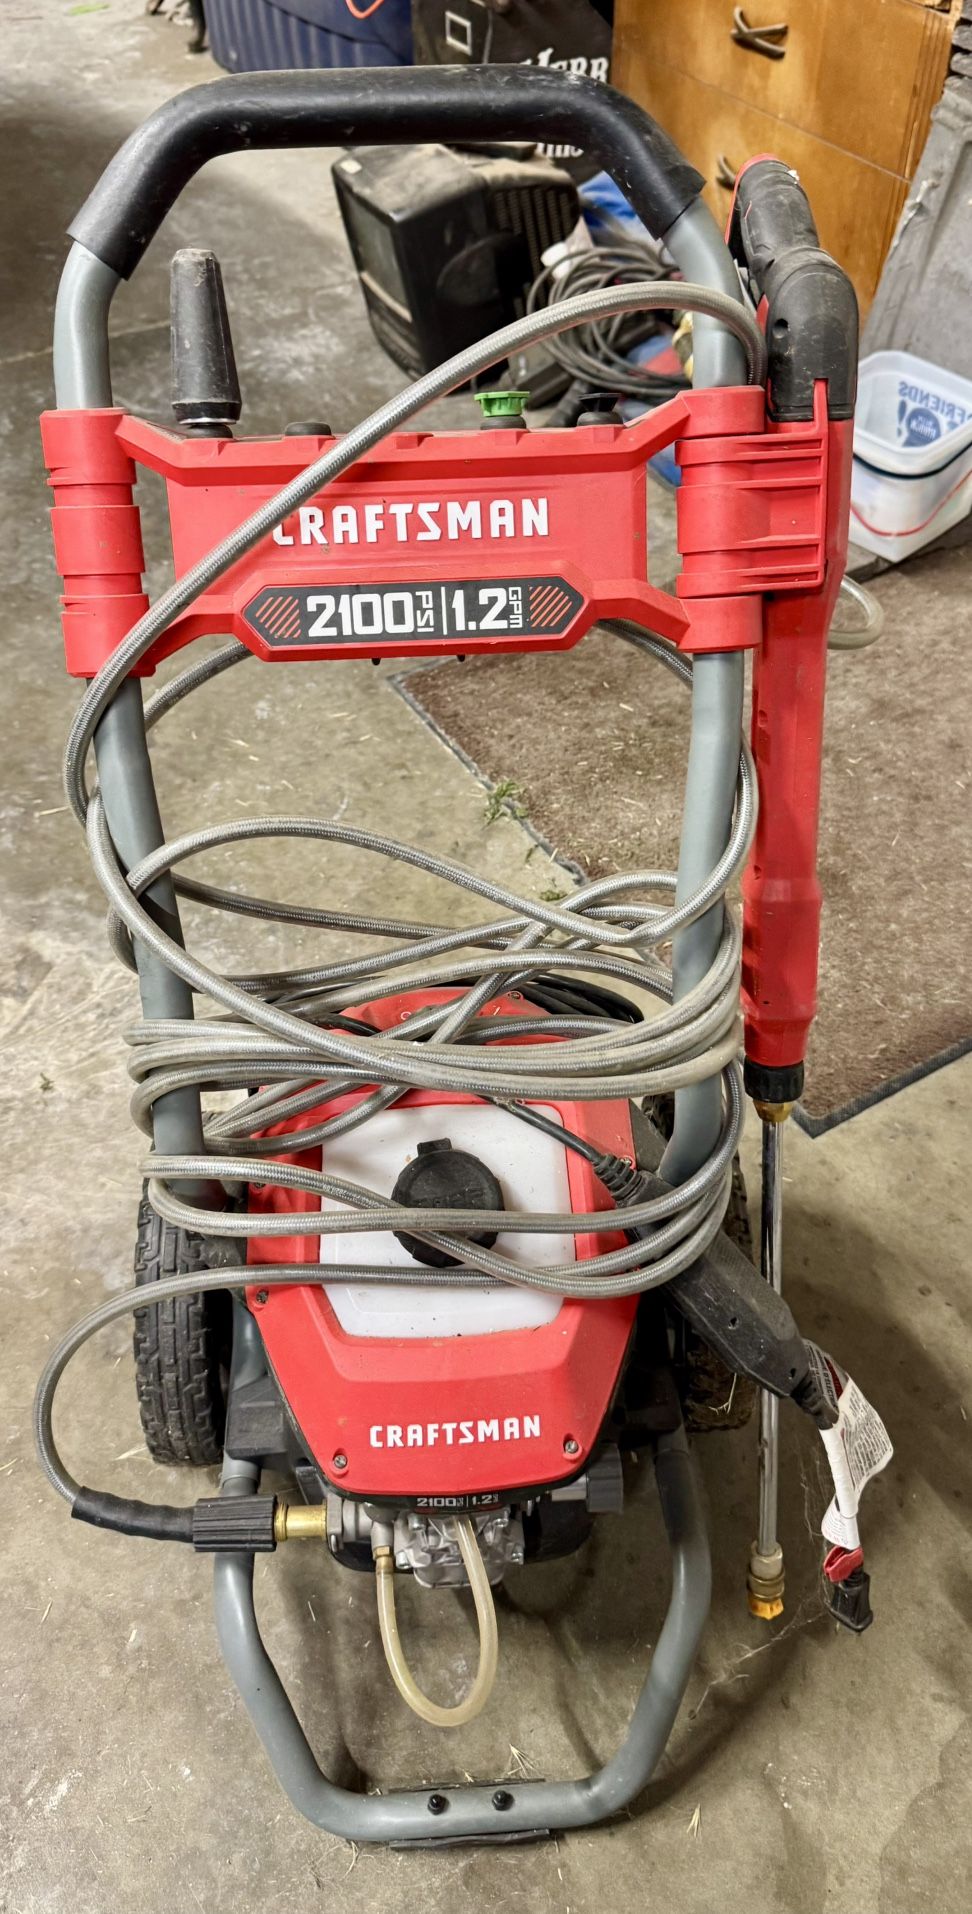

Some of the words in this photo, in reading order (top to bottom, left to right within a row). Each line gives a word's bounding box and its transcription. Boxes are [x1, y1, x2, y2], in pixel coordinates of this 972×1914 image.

[306, 592, 414, 637] 2100
[416, 591, 434, 632] PSI
[452, 588, 508, 630] 1.2
[370, 1415, 541, 1447] CRAFTSMAN
[416, 1497, 457, 1507] 2100
[472, 1494, 492, 1505] 1.2
